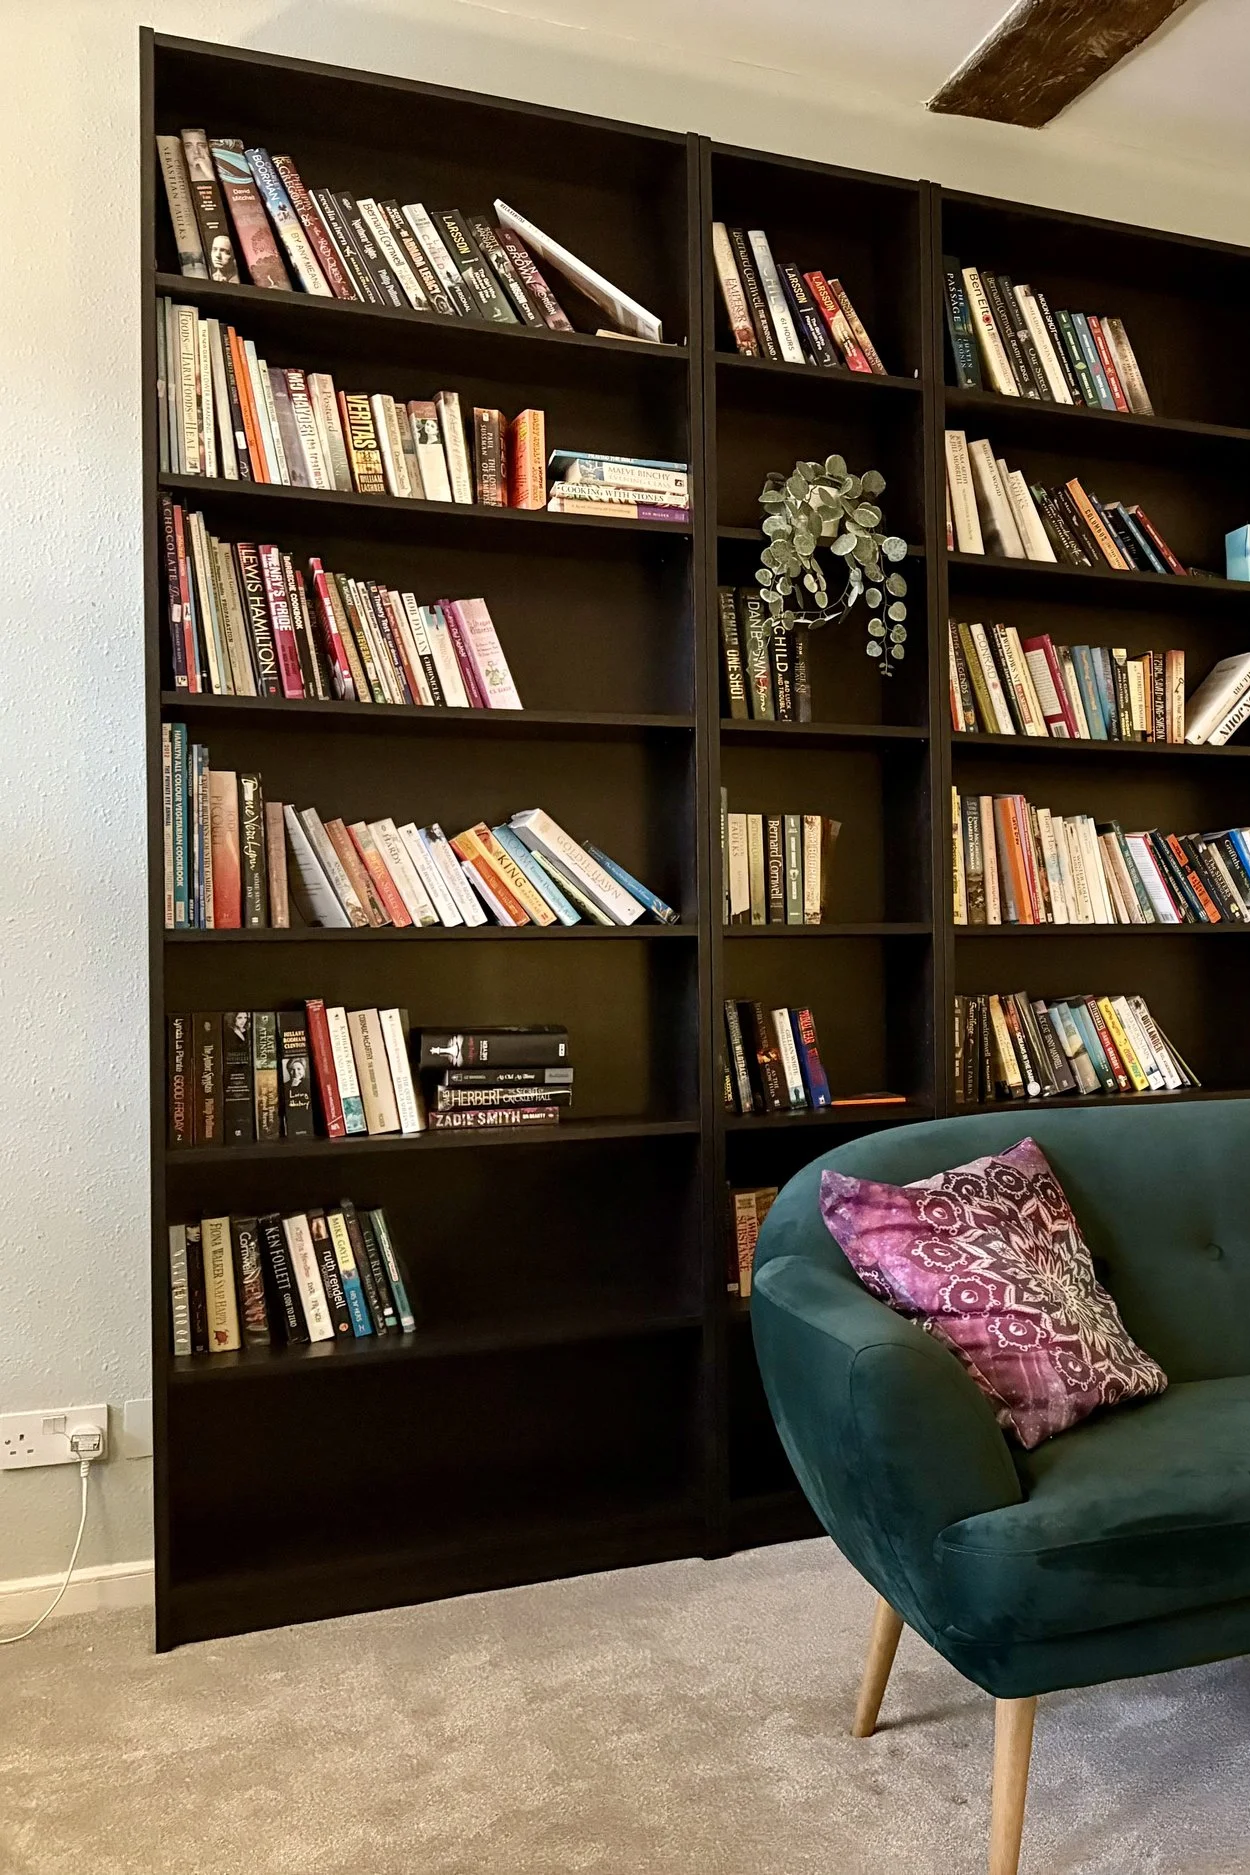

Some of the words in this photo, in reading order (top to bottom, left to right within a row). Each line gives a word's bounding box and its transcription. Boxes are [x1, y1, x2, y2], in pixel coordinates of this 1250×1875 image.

[252, 154, 280, 202] BOORMAN
[278, 165, 305, 213] GREGORY
[290, 171, 313, 212] PHILIPPA
[331, 220, 349, 246] ahern
[362, 200, 388, 237] Bernard
[380, 234, 404, 267] Cornwell
[442, 213, 470, 255] LARSSON
[483, 226, 498, 247] SCOTT
[290, 231, 300, 243] BY
[296, 243, 308, 261] ANY
[302, 260, 320, 289] MEANS
[505, 242, 534, 286] BROWN
[518, 250, 539, 275] DAN
[732, 229, 751, 266] Bernard
[742, 266, 765, 309] Cornwell
[418, 265, 440, 296] LEGACY
[784, 266, 808, 305] LARSSON
[811, 274, 836, 312] LARSSON
[947, 272, 961, 322] PASSAGE
[454, 284, 471, 312] PERSONAL
[968, 271, 982, 297] Ben
[976, 297, 994, 332] Elton
[986, 275, 1004, 306] Bernard
[996, 305, 1015, 338] Cornwell
[1036, 292, 1051, 316] MOON
[1044, 314, 1057, 333] SHOT
[767, 341, 776, 355] LAND
[782, 325, 795, 352] HOURS
[957, 338, 966, 367] CRONIN
[963, 338, 973, 367] JUSTIN
[1008, 338, 1021, 359] DEATH
[1018, 364, 1029, 382] KINGS
[1027, 346, 1039, 365] Our
[1034, 365, 1049, 392] Street
[292, 390, 315, 437] HAYDER
[322, 391, 338, 434] Postcard
[345, 392, 377, 452] VERITAS
[481, 462, 488, 473] OF
[488, 459, 496, 471] THE
[489, 474, 497, 490] LOST
[608, 466, 636, 476] MAEVE
[637, 470, 670, 481] BINCHY
[980, 443, 995, 473] MICHAEL
[991, 474, 1003, 497] WOOD
[562, 485, 602, 495] COOKING
[631, 492, 664, 501] STONES
[1084, 508, 1107, 541] COLUMBUS
[162, 508, 177, 581] CHOCOLATE
[240, 547, 263, 593] LEWIS
[265, 553, 285, 599] HENRY'S
[275, 599, 291, 631] PRIDE
[282, 555, 295, 591] BARBECUE
[289, 592, 303, 630] COOKBOOK
[372, 594, 385, 616] Theory
[381, 618, 390, 633] Test
[405, 594, 417, 616] BOB
[411, 617, 428, 653] DYLAN
[747, 600, 762, 627] DAN
[249, 594, 277, 675] HAMILTON
[773, 625, 789, 672] CHILD
[725, 648, 740, 671] ONE
[975, 632, 996, 680] CONRAD
[1001, 638, 1017, 672] WINDOWS
[422, 655, 441, 701] CHRONICLES
[729, 672, 744, 702] SHOT
[956, 657, 969, 693] LEGENDS
[778, 687, 786, 713] TROUBLE
[1155, 700, 1164, 715] KING
[1155, 718, 1165, 739] SWEDEN
[1218, 707, 1246, 738] JOHN
[174, 773, 182, 801] COLOUR
[175, 802, 183, 844] VEGETARIAN
[244, 815, 259, 838] Vera
[730, 820, 739, 856] FAULKS
[767, 820, 781, 857] Bernard
[244, 838, 261, 871] Lynn
[381, 832, 401, 866] HARDY
[1222, 837, 1243, 870] Griffiths
[496, 852, 526, 888] KING
[555, 834, 593, 871] GOLDIE
[590, 869, 622, 899] HAWN
[769, 859, 782, 898] Cornwell
[1075, 855, 1084, 881] WINTER
[1208, 858, 1217, 870] The
[1214, 869, 1231, 898] SISTERS
[173, 1018, 183, 1038] Lynda
[358, 1013, 368, 1034] CORMAC
[980, 1007, 988, 1030] Bernard
[1140, 1013, 1164, 1053] OUTLANDER
[175, 1040, 183, 1049] La
[259, 1027, 267, 1065] ATKINSON
[266, 1035, 274, 1053] KATE
[784, 1029, 794, 1053] GILLIAN
[789, 1055, 799, 1076] WHITE
[983, 1031, 991, 1056] Cornwell
[175, 1050, 183, 1072] Plante
[174, 1074, 183, 1099] GOOD
[452, 1089, 503, 1106] HERBERT
[537, 1093, 553, 1101] HALL
[174, 1101, 183, 1131] FRIDAY
[436, 1114, 474, 1126] ZADIE
[478, 1111, 520, 1125] SMITH
[210, 1223, 222, 1246] FIONA
[265, 1225, 282, 1248] KEN
[331, 1217, 343, 1237] MIKE
[337, 1239, 350, 1264] GAYLE
[737, 1215, 748, 1272] SUBSTANCE
[212, 1248, 224, 1277] WALKER
[239, 1231, 254, 1275] Cornwell
[269, 1248, 291, 1291] FOLLETT
[322, 1250, 336, 1271] ruth
[370, 1258, 385, 1284] REES
[213, 1280, 225, 1298] SNAP
[282, 1292, 292, 1306] CODE
[327, 1272, 346, 1308] rendell
[214, 1301, 227, 1325] HAPPY
